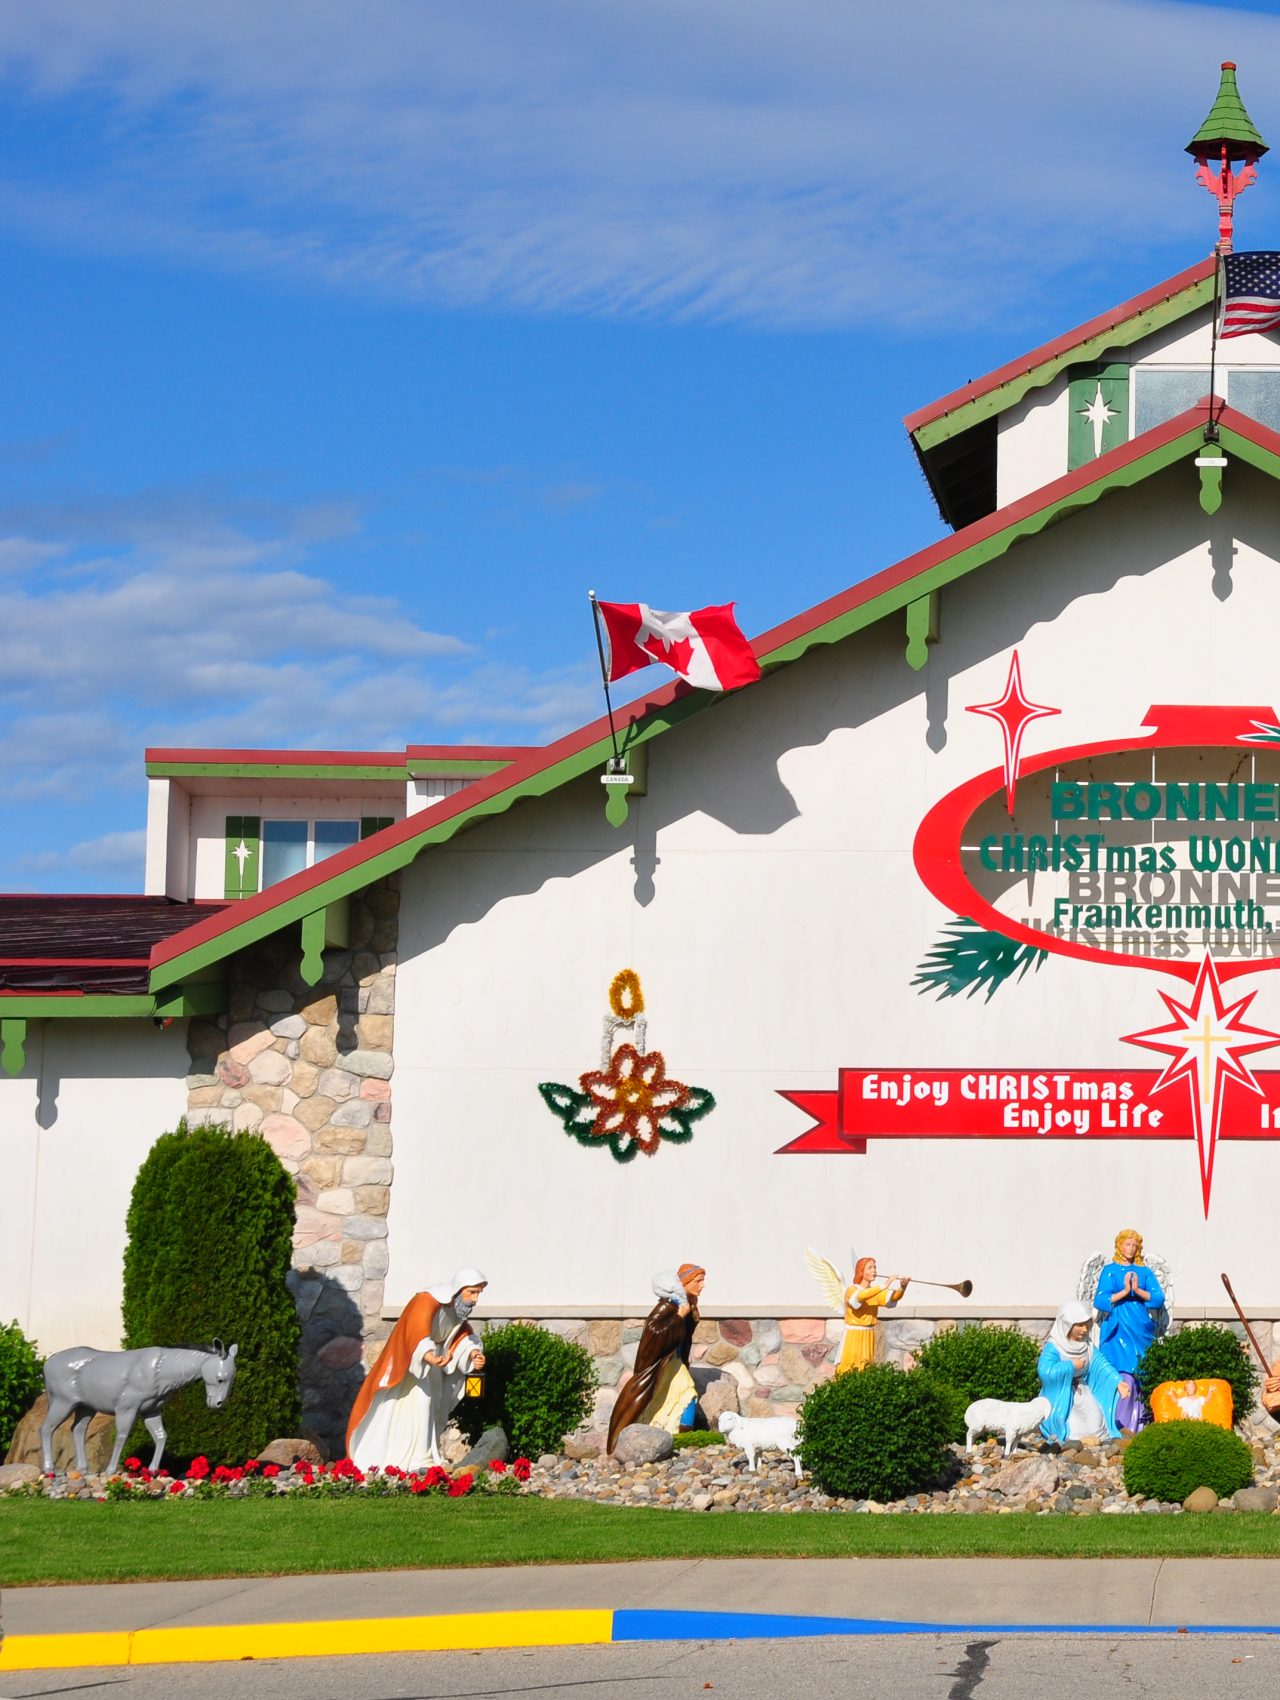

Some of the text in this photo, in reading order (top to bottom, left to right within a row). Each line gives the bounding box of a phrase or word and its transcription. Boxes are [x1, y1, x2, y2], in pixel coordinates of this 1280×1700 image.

[979, 833, 1176, 874] CHRISTmas
[1054, 898, 1272, 934] Frankenmuth,
[862, 1074, 1134, 1106] Enjoy CHRISTmas
[1003, 1102, 1164, 1134] Enjoy Life
